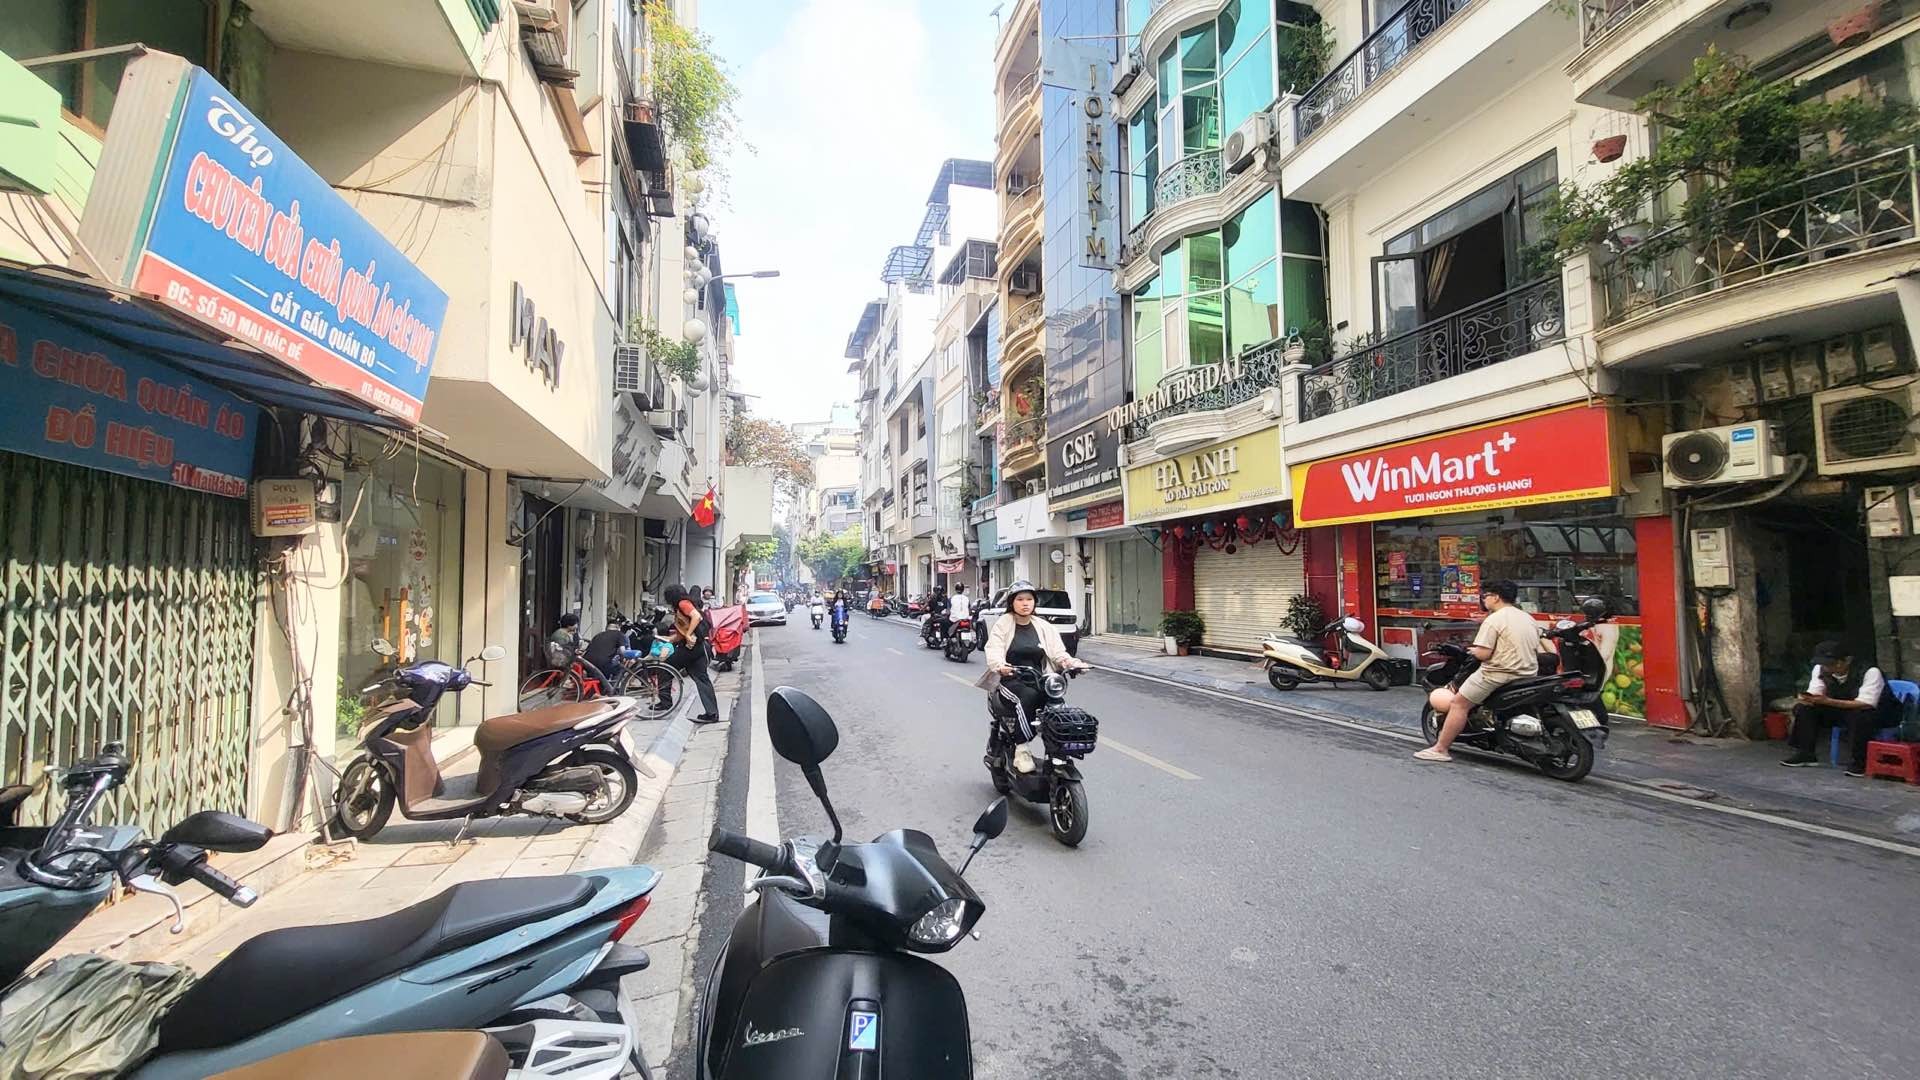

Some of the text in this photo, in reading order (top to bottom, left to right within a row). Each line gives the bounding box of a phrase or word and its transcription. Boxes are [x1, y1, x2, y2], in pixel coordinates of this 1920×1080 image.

[196, 296, 219, 319] SỐ
[218, 306, 236, 328] 50
[237, 316, 263, 342] MAI
[1143, 385, 1172, 417] KIM
[1175, 353, 1246, 403] BRIDAL
[1062, 430, 1096, 468] GSE
[1190, 446, 1239, 483] ANH
[1425, 490, 1453, 501] NGON
